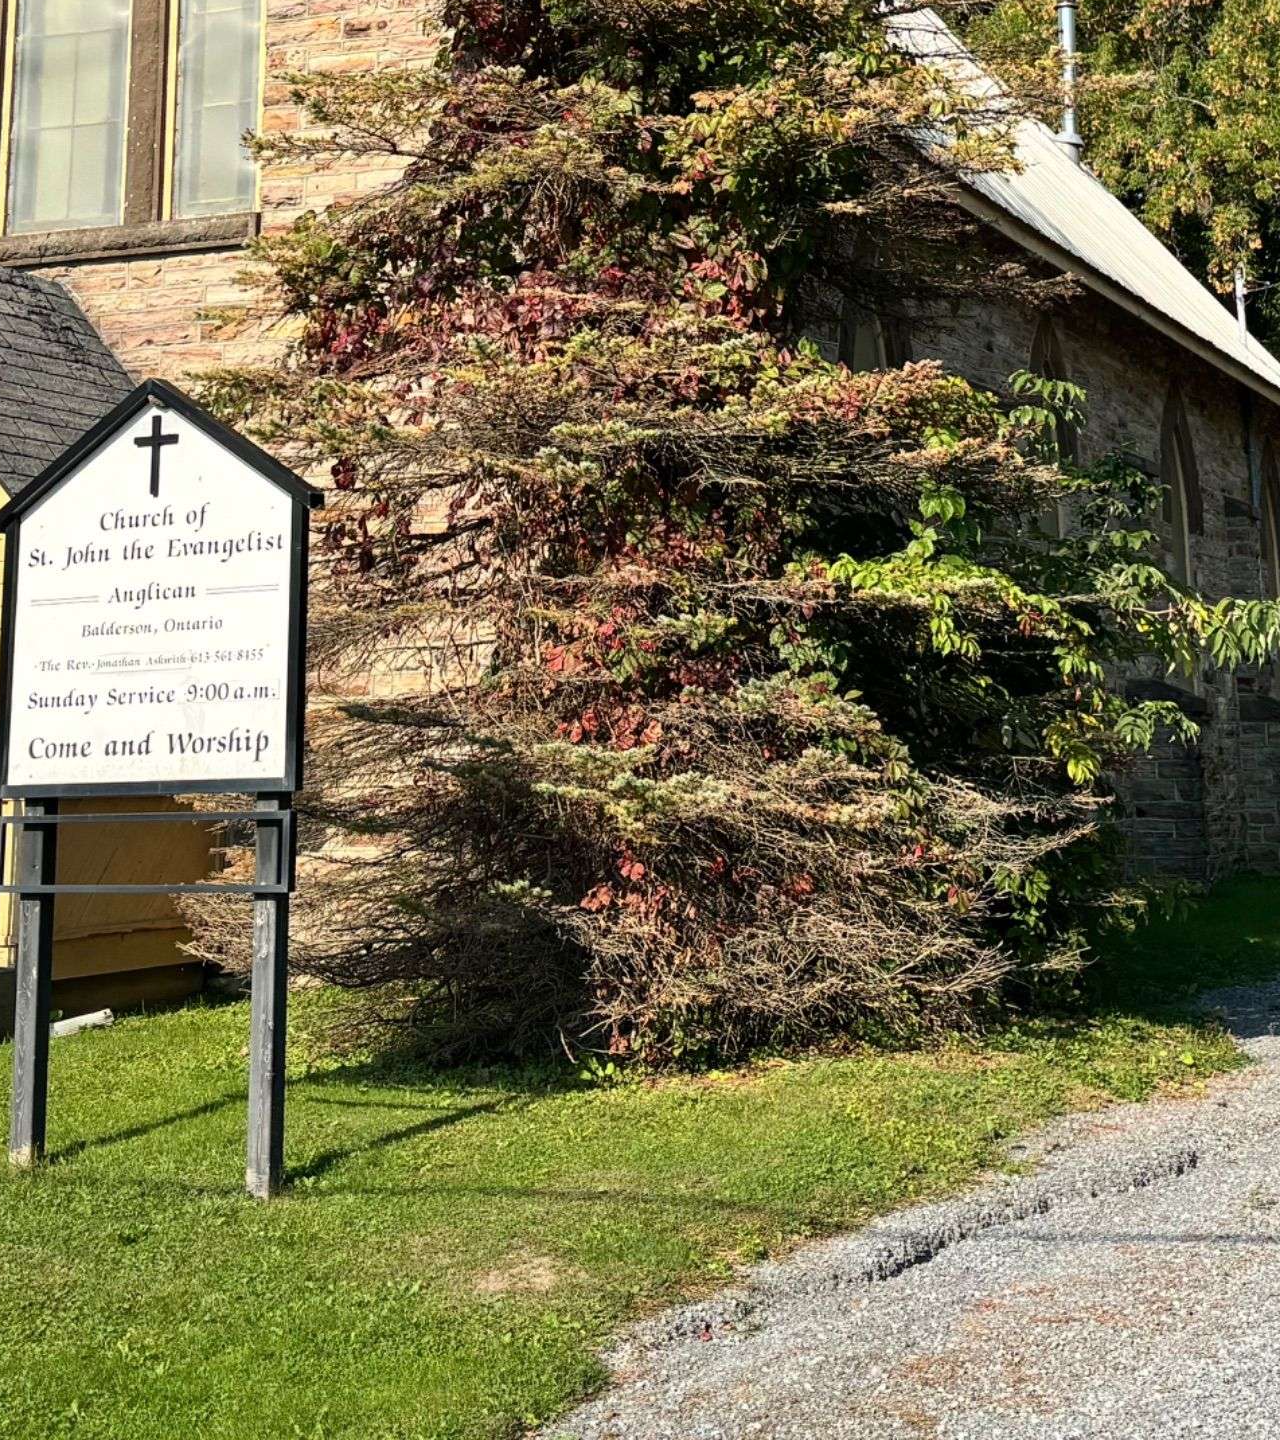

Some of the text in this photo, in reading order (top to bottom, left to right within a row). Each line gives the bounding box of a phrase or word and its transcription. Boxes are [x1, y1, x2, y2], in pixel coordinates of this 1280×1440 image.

[99, 502, 211, 532] Church of
[28, 530, 283, 570] St. John the Evangelist
[108, 582, 196, 609] Anglican
[81, 615, 223, 638] Balderson, Ontario
[40, 660, 61, 672] The
[96, 657, 141, 670] Jonathan
[28, 682, 276, 715] Sunday Service 9:00 a.m.
[28, 727, 269, 762] Come and Worship
